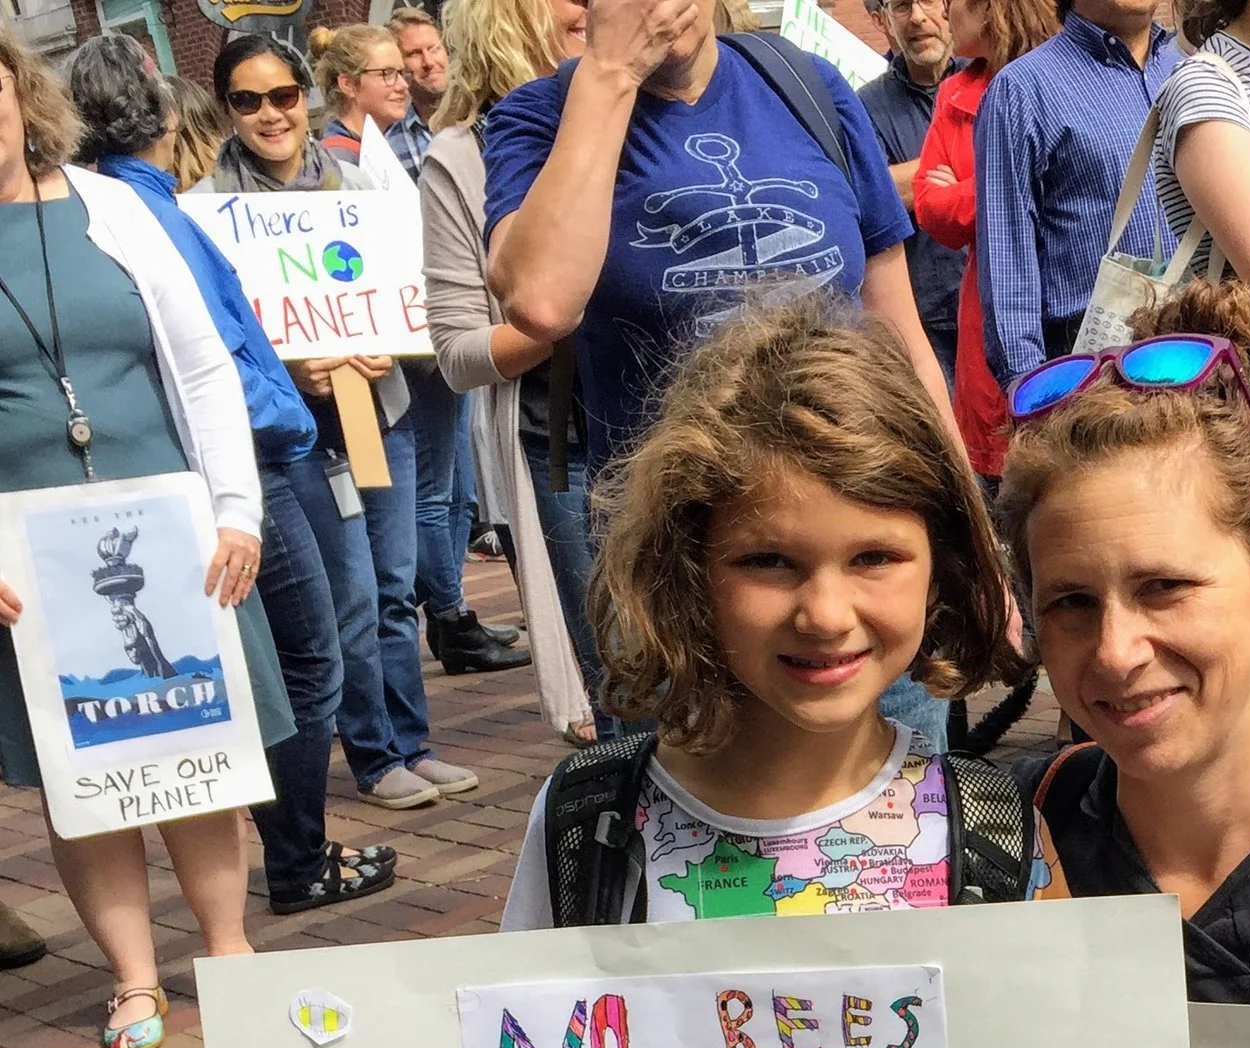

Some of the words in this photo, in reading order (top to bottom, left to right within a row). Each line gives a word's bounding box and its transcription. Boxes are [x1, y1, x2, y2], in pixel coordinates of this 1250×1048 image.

[337, 201, 359, 228] is
[697, 207, 795, 232] LAKE
[253, 288, 377, 346] LANET
[399, 285, 430, 333] B
[77, 681, 216, 724] TORCH
[74, 764, 160, 800] SAVE
[177, 751, 232, 780] OUR
[119, 779, 219, 821] PLANET
[868, 811, 904, 820] Warsaw
[818, 838, 847, 847] CZECH
[850, 837, 868, 845] REP.
[862, 848, 904, 857] SLOVAKIA
[715, 855, 738, 864] Paris
[869, 858, 912, 867] Bratislava
[820, 865, 859, 874] AUSTRIA
[891, 866, 933, 875] Budapest
[698, 876, 748, 891] FRANCE
[860, 876, 903, 886] HUNGARY
[893, 889, 932, 898] Belgrade
